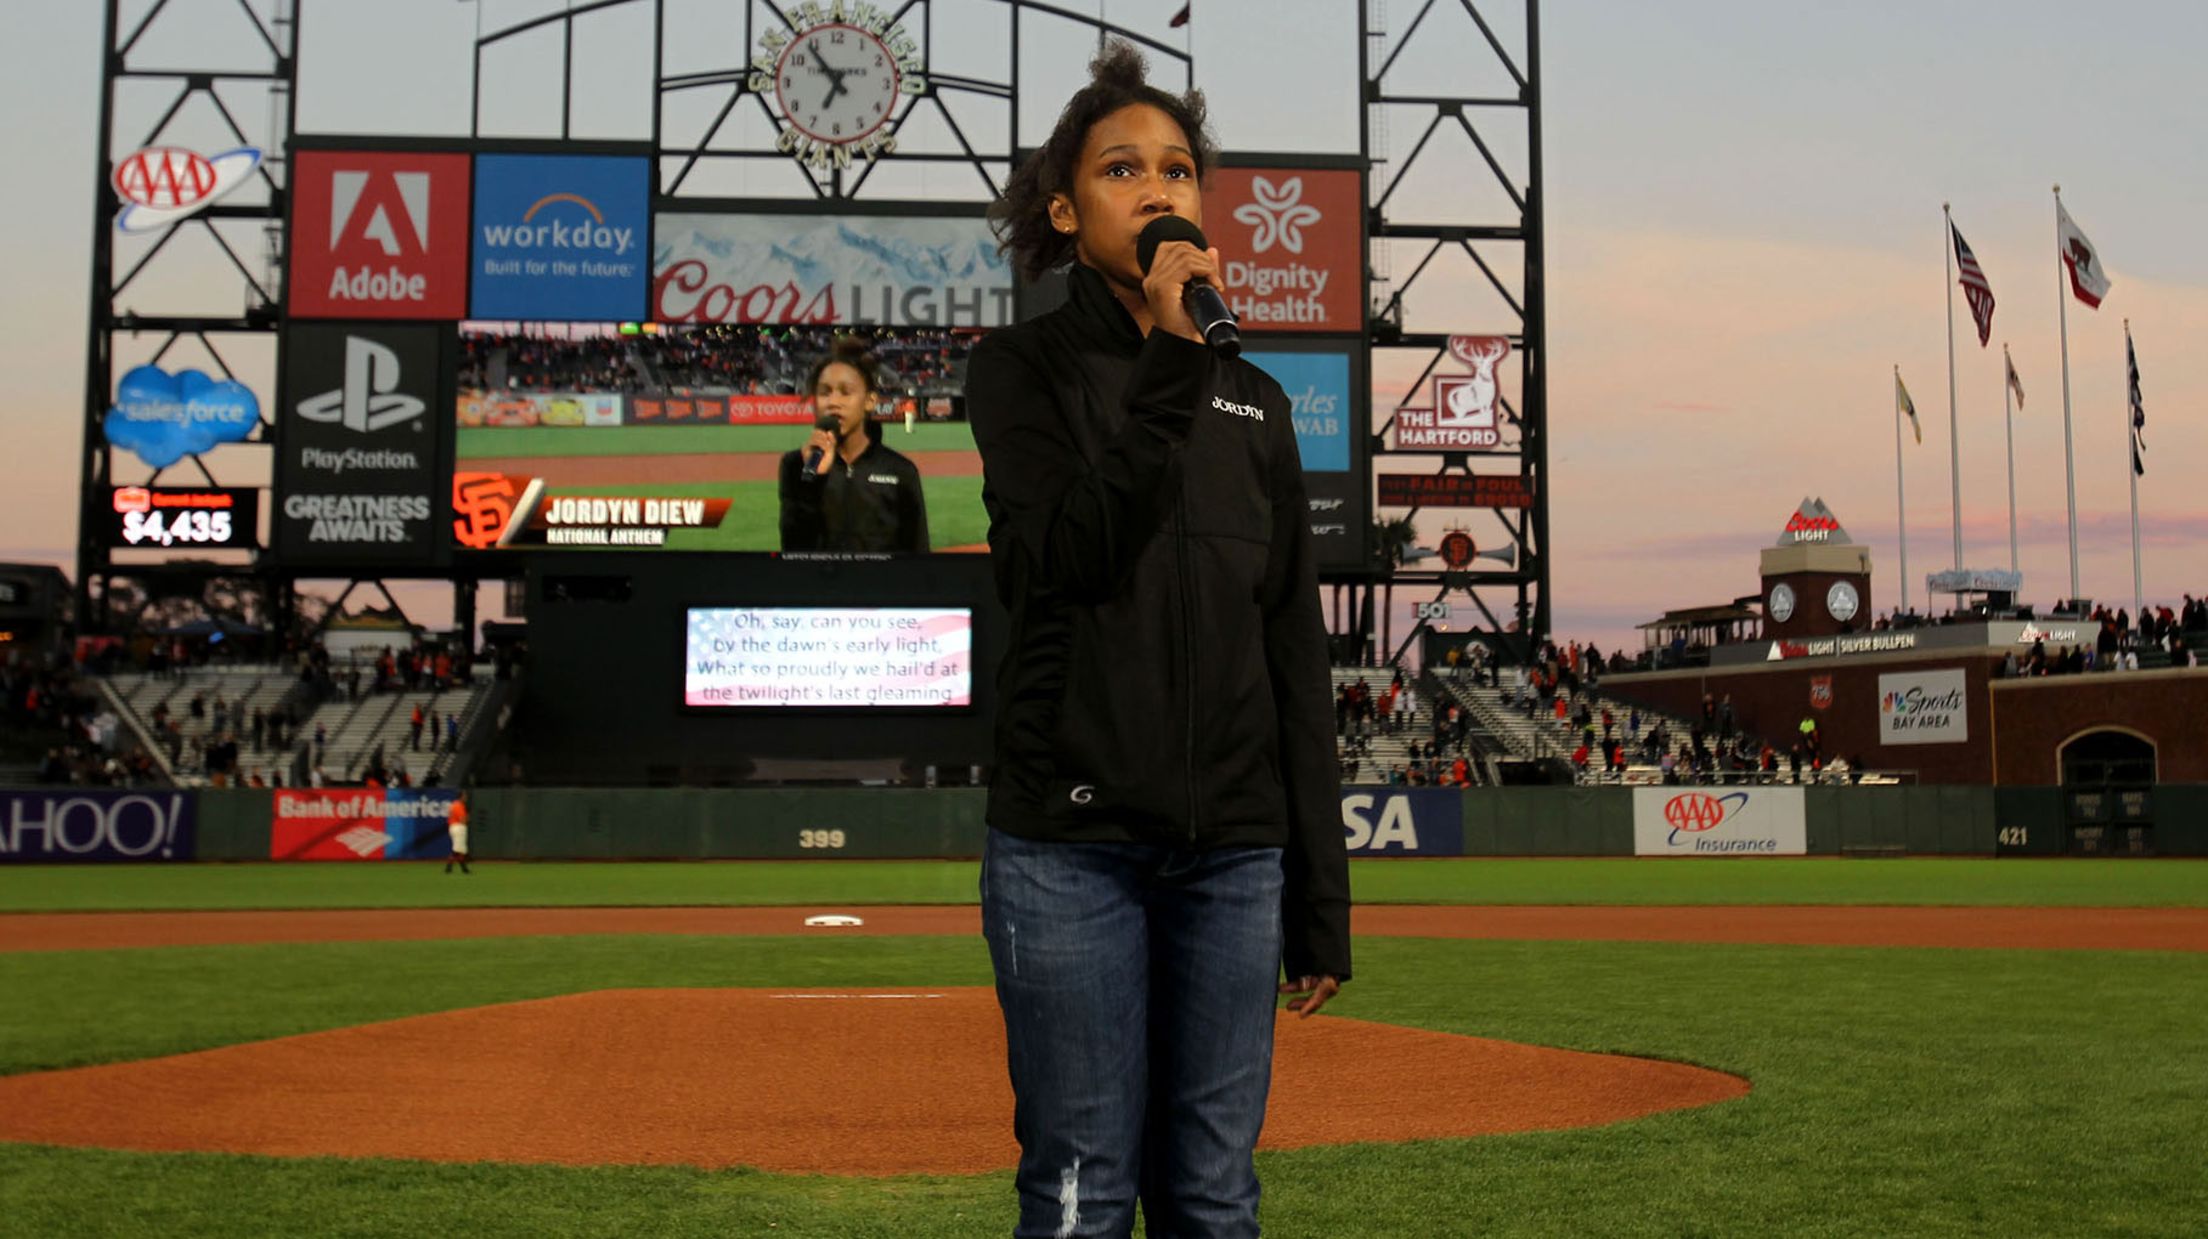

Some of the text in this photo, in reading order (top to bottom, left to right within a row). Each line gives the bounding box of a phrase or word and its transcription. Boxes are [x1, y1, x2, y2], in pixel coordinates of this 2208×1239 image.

[831, 31, 845, 44] 12
[791, 54, 805, 67] 10
[874, 54, 883, 67] 2
[882, 78, 890, 90] 3
[873, 101, 881, 113] 4
[809, 115, 818, 128] 7
[121, 151, 208, 205] AAA
[483, 218, 632, 255] workday
[485, 259, 520, 275] Built
[525, 260, 546, 275] for
[553, 261, 576, 275] the
[329, 266, 426, 300] Adobe
[1226, 262, 1328, 297] Dignity
[653, 260, 1014, 326] Coors LIGHT
[1231, 296, 1326, 322] Health
[124, 401, 245, 428] salesforce
[1212, 396, 1264, 421] JORDYN
[1401, 410, 1434, 427] THE
[1400, 428, 1497, 446] HARTFORD
[302, 448, 417, 474] PlayStation
[284, 495, 430, 520] GREATNESS
[546, 498, 704, 525] JORDYN DIEW
[123, 509, 232, 546] $4,435
[309, 520, 405, 542] AWAITS
[547, 528, 664, 545] NATIONAL ANTHEM
[1795, 529, 1829, 541] LIGHT
[811, 616, 842, 629] can
[849, 616, 882, 633] you
[1808, 640, 1834, 656] LIGHT
[1841, 637, 1872, 653] SILVER
[1873, 633, 1916, 650] BULLPEN
[2049, 629, 2077, 641] LIGHT
[713, 638, 736, 656] by
[741, 637, 771, 652] the
[777, 637, 840, 653] dawn's
[846, 637, 891, 656] early
[697, 660, 959, 680] What so proudly we hail'd at
[703, 686, 953, 705] the twilight's last gleaming
[1906, 686, 1963, 714] Sports
[1893, 714, 1950, 730] BAY AREA
[278, 796, 451, 819] Bank of America
[1670, 793, 1721, 830] AAA
[0, 794, 184, 858] HOO!
[1999, 826, 2028, 846] 421
[799, 829, 845, 848] 399
[1695, 836, 1777, 852] Insurance
